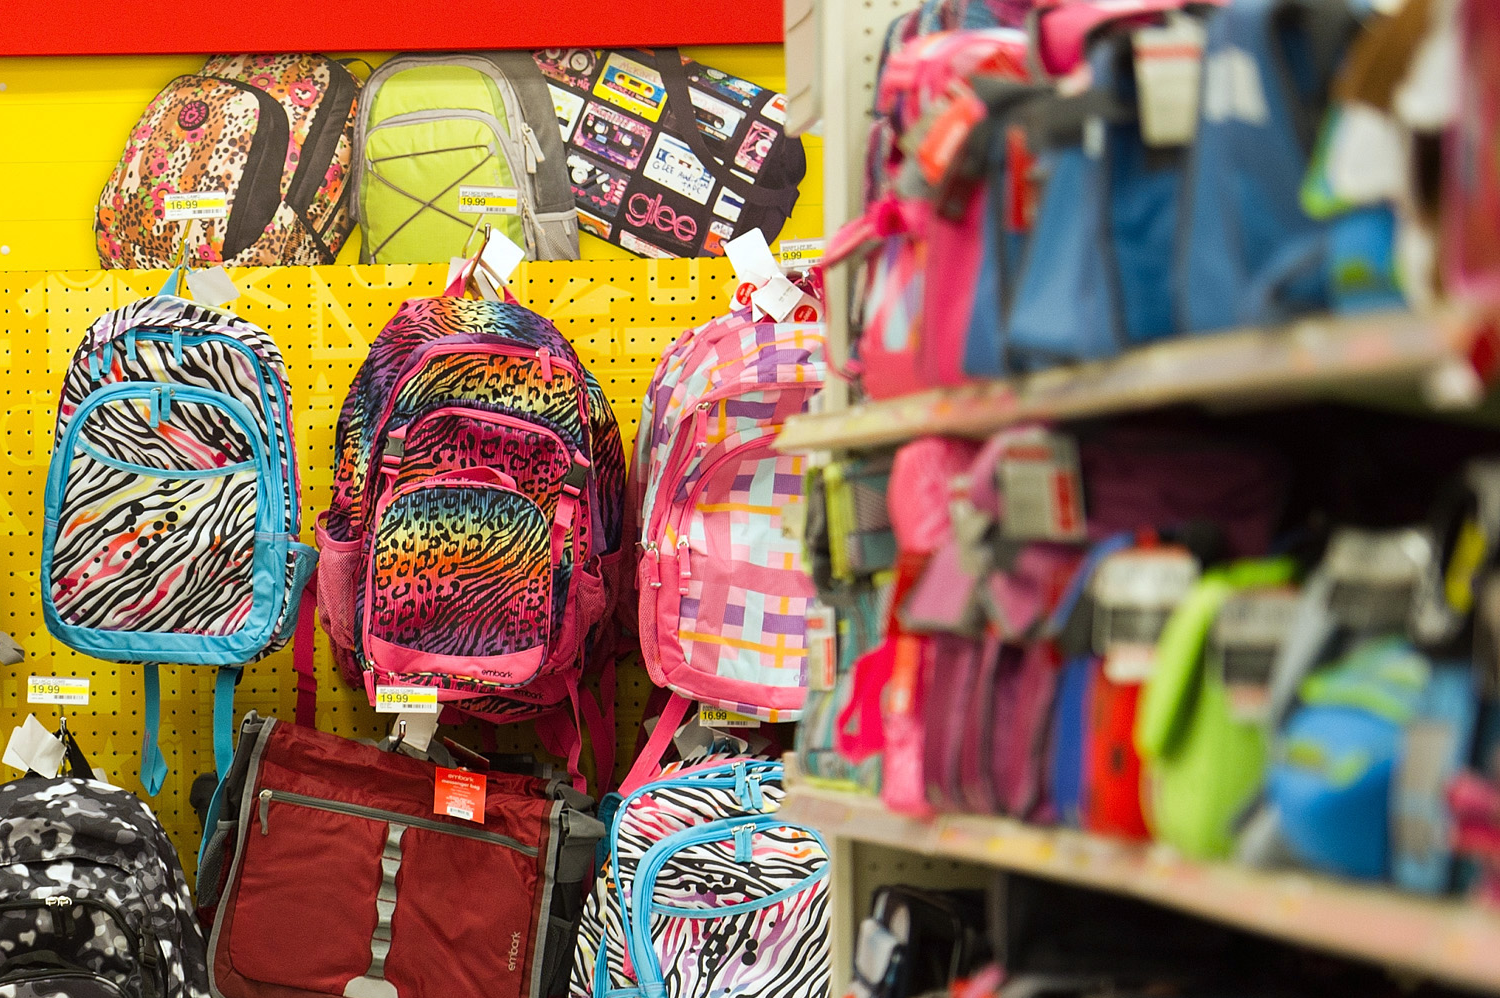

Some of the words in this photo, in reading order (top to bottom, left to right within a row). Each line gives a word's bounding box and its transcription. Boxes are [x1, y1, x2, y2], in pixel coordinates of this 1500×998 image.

[171, 200, 198, 210] 16.99
[462, 197, 486, 206] 19.99
[625, 192, 698, 242] glee
[782, 252, 802, 260] 9.99
[481, 669, 513, 679] embark
[32, 685, 60, 694] 19.99
[381, 694, 409, 703] 19.99
[514, 689, 544, 700] embark
[702, 711, 727, 720] 16.99
[448, 774, 474, 782] embark
[508, 931, 521, 971] embark
